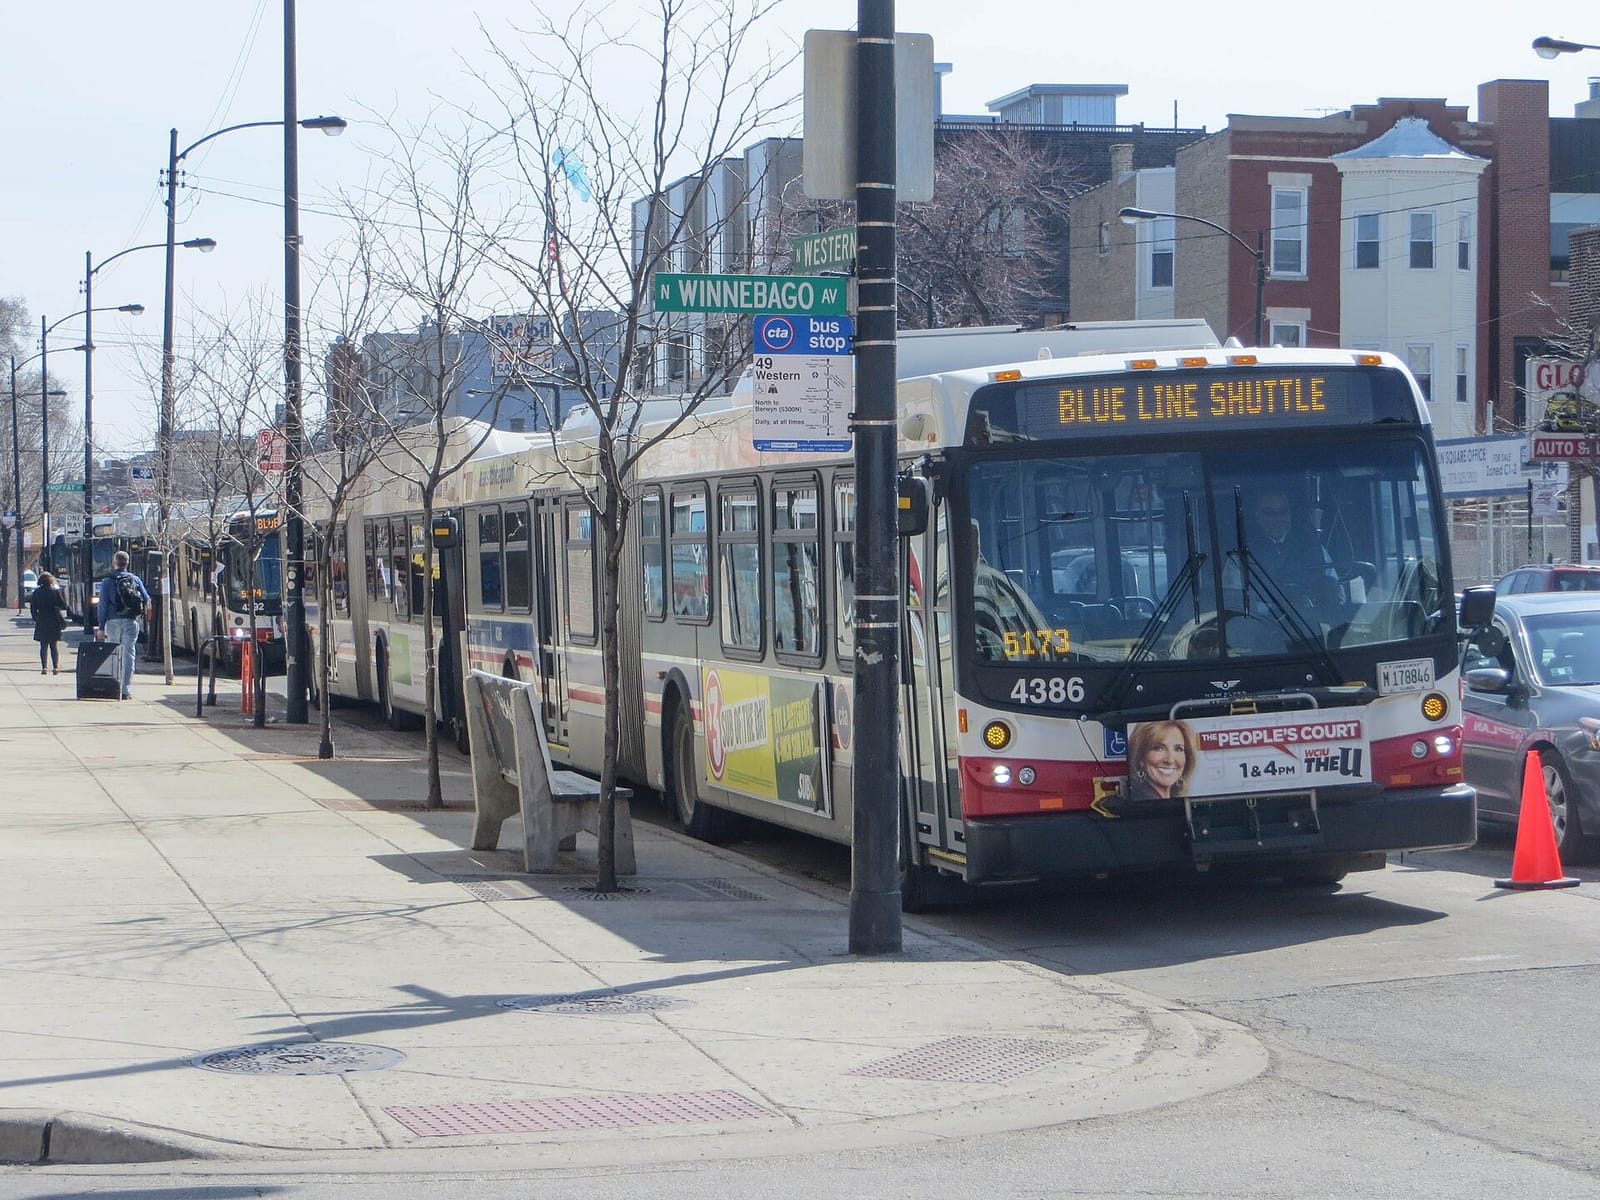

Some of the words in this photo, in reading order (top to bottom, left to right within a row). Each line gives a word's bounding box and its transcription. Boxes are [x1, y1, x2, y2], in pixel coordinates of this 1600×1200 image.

[804, 232, 856, 267] WESTERN
[661, 284, 670, 300] N
[678, 280, 814, 310] WINNEBAGO
[821, 288, 837, 304] AV
[767, 327, 789, 338] cta
[809, 318, 840, 333] bus
[809, 335, 846, 352] stop
[755, 357, 773, 369] 49
[755, 370, 801, 380] Western
[1537, 364, 1586, 391] GLO
[1059, 387, 1126, 423] BLUE
[1137, 383, 1198, 420] LINE
[1210, 377, 1325, 416] SHUTTLE
[1536, 441, 1574, 455] AUTO
[1003, 628, 1070, 655] 5173
[1393, 667, 1430, 686] 178846
[1010, 676, 1085, 704] 4386
[1201, 733, 1218, 742] THE
[1218, 727, 1298, 747] PEOPLE'S
[1300, 723, 1358, 741] COURT
[1304, 749, 1330, 757] WCIU
[1304, 756, 1340, 773] THE
[1338, 747, 1363, 778] U
